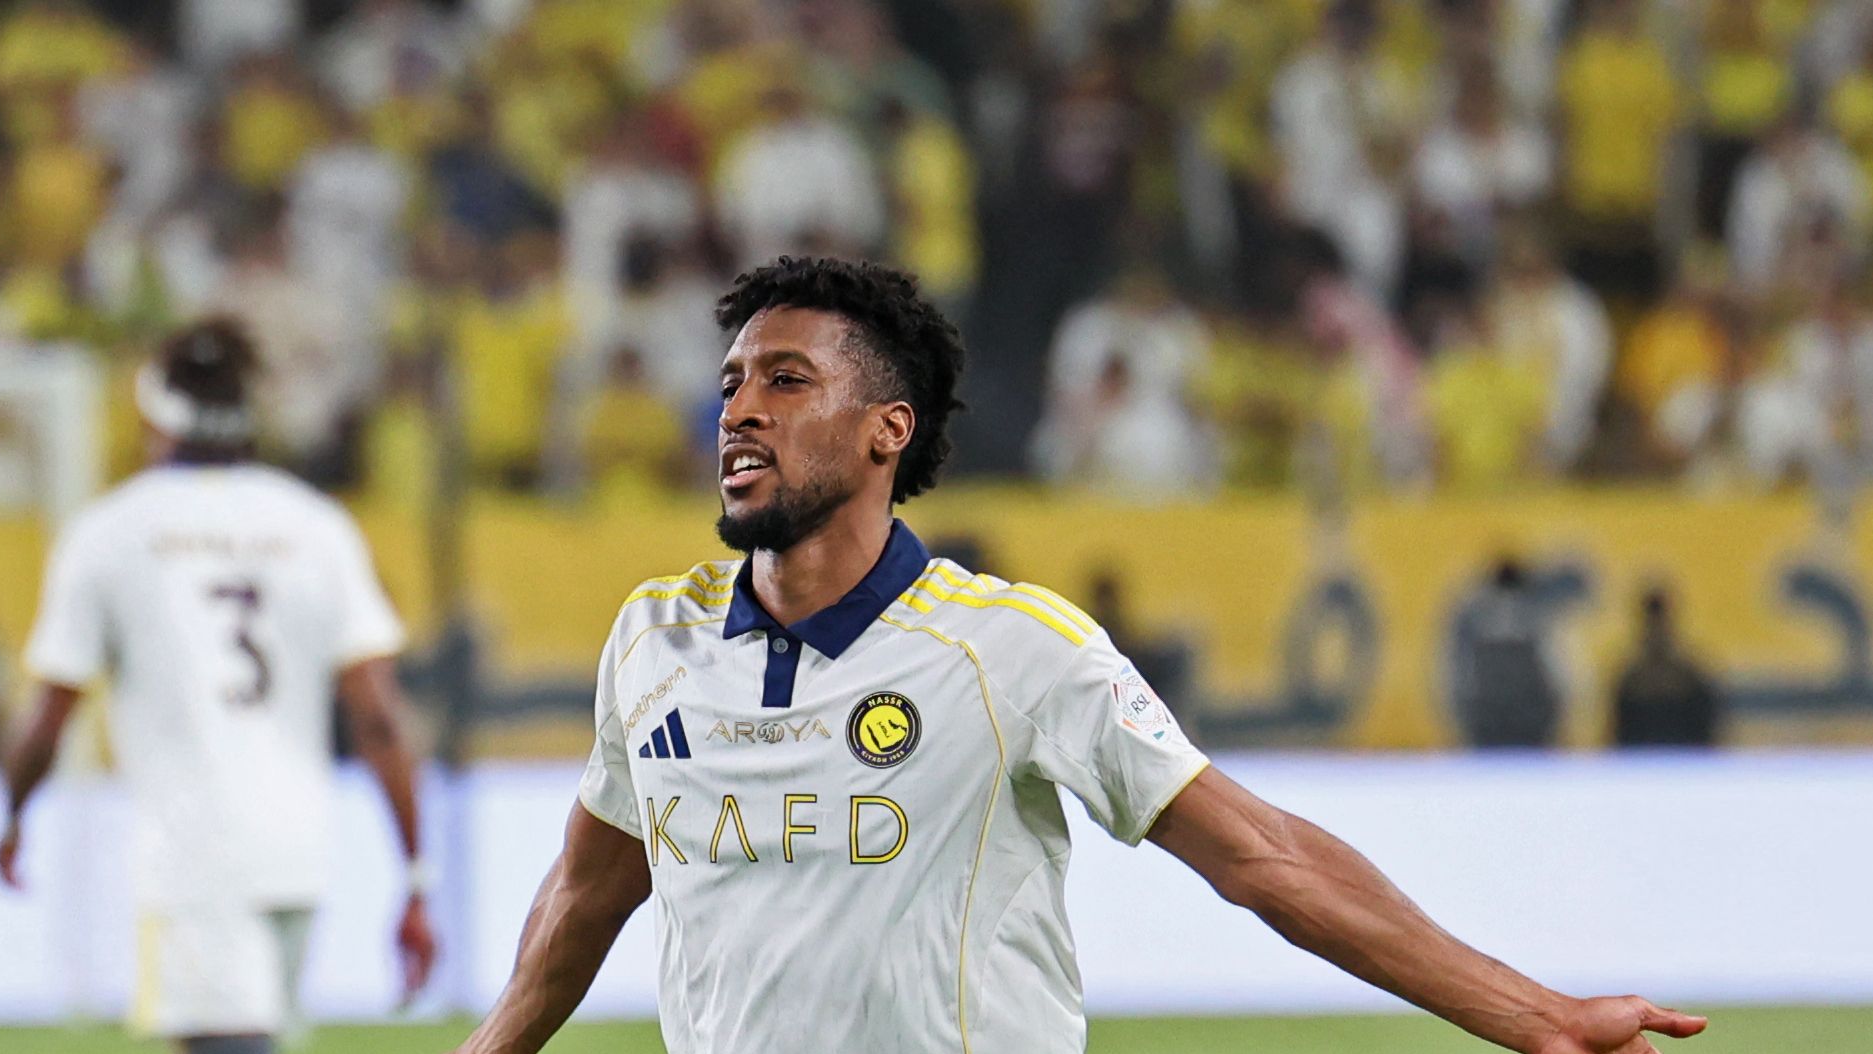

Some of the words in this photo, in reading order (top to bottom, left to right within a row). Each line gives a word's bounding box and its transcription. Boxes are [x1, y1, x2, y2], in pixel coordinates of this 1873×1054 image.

[209, 583, 271, 705] 3
[868, 696, 903, 707] NASSR
[1130, 693, 1151, 714] RSL
[705, 718, 832, 745] AROYA
[647, 794, 908, 866] KAFD
